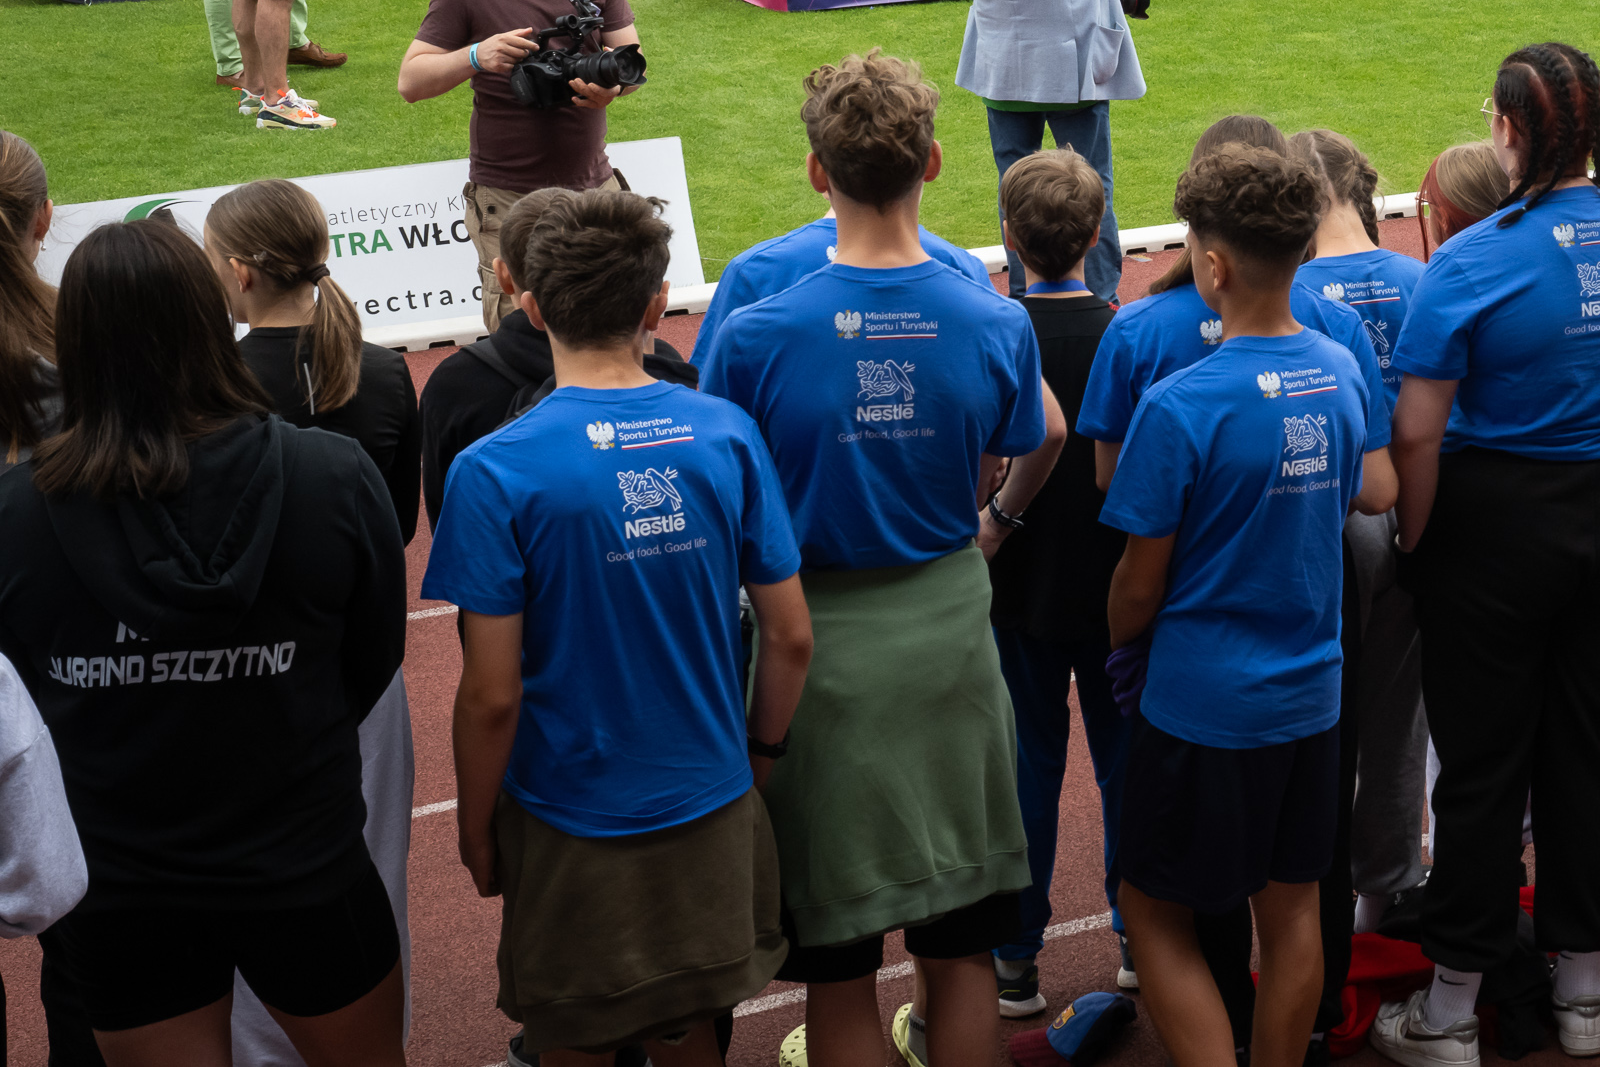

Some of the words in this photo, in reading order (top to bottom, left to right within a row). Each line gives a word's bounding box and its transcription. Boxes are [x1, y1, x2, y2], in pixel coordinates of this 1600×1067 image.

[1577, 230, 1600, 240] Sportu
[865, 311, 921, 321] Ministerstwo
[864, 322, 894, 333] Sportu
[900, 320, 938, 331] Turystyki
[1564, 324, 1586, 336] Good
[1281, 367, 1322, 380] Ministerstwo
[1283, 378, 1306, 390] Sportu
[1309, 373, 1337, 386] Turystyki
[856, 403, 915, 422] Nestlé
[615, 416, 673, 430] Ministerstwo
[618, 429, 648, 442] Sportu
[653, 424, 693, 437] Turystyki
[837, 431, 863, 443] Good
[864, 430, 891, 441] food,
[892, 427, 919, 439] Good
[920, 427, 936, 438] life
[1281, 454, 1328, 478] Nestlé
[1309, 479, 1330, 491] Good
[624, 512, 686, 540] Nestlé
[606, 548, 635, 563] Good
[636, 546, 662, 559] food,
[664, 540, 693, 553] Good
[694, 537, 707, 548] life
[150, 640, 297, 684] SZCZYTNO
